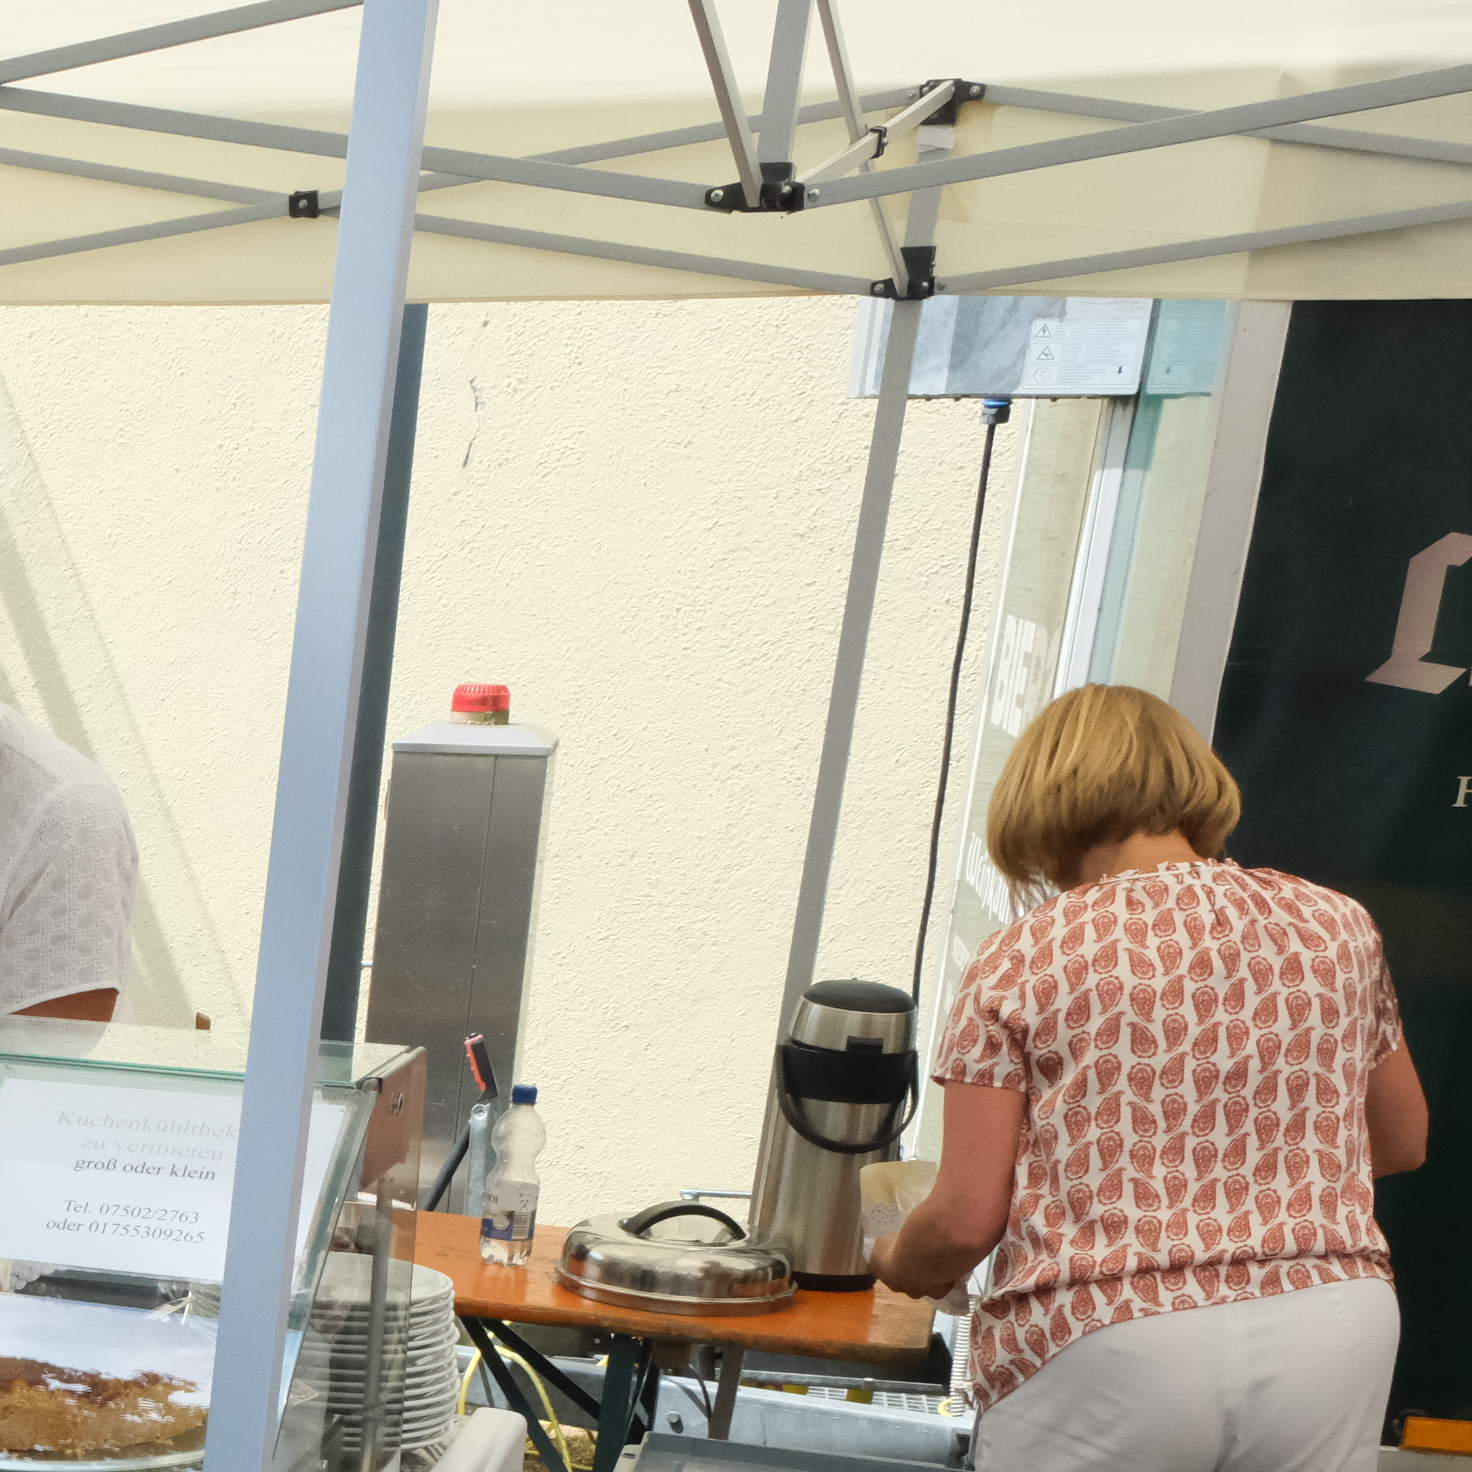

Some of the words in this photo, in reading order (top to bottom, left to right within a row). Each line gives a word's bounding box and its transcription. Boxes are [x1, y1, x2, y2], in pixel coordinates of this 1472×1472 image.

[57, 1109, 239, 1140] Kuchenkühlthek
[79, 1138, 106, 1151] zu
[115, 1140, 224, 1162] vermieten
[73, 1158, 118, 1173] groß
[122, 1161, 165, 1176] oder
[170, 1164, 216, 1180] klein
[64, 1199, 92, 1214] Tel.
[99, 1203, 200, 1224] 07502/2763
[46, 1218, 85, 1232] oder
[88, 1221, 205, 1244] 01755309265
